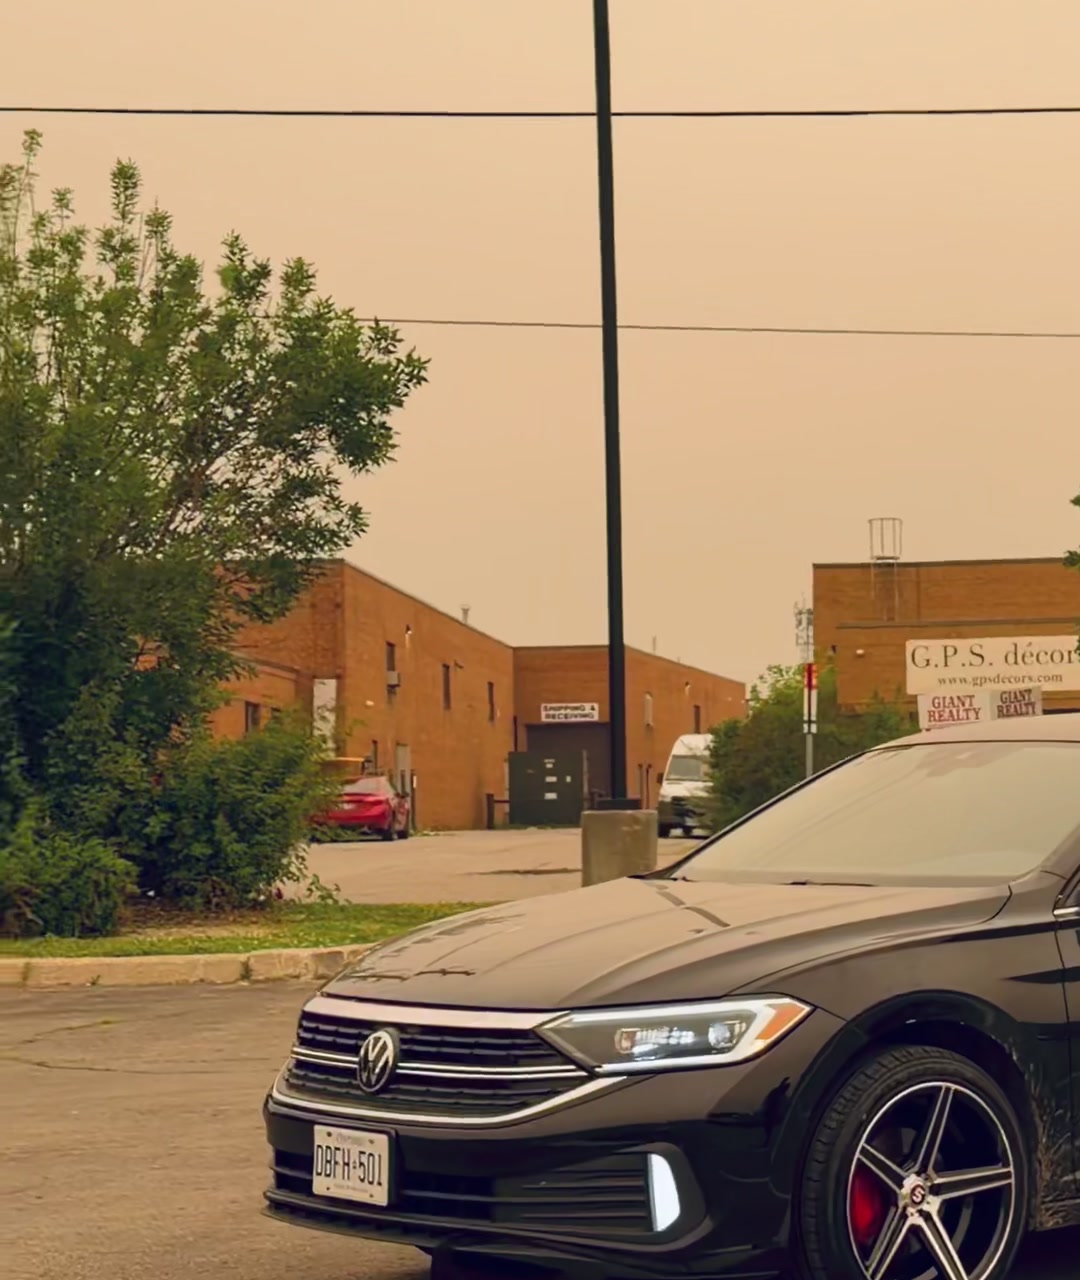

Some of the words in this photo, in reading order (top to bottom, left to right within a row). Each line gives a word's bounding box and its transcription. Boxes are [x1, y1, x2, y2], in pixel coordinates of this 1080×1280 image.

[911, 643, 993, 669] G.P.S.
[932, 695, 976, 709] GIANT
[1000, 689, 1033, 705] GIANT
[927, 707, 982, 722] REALTY
[997, 702, 1037, 719] REALTY
